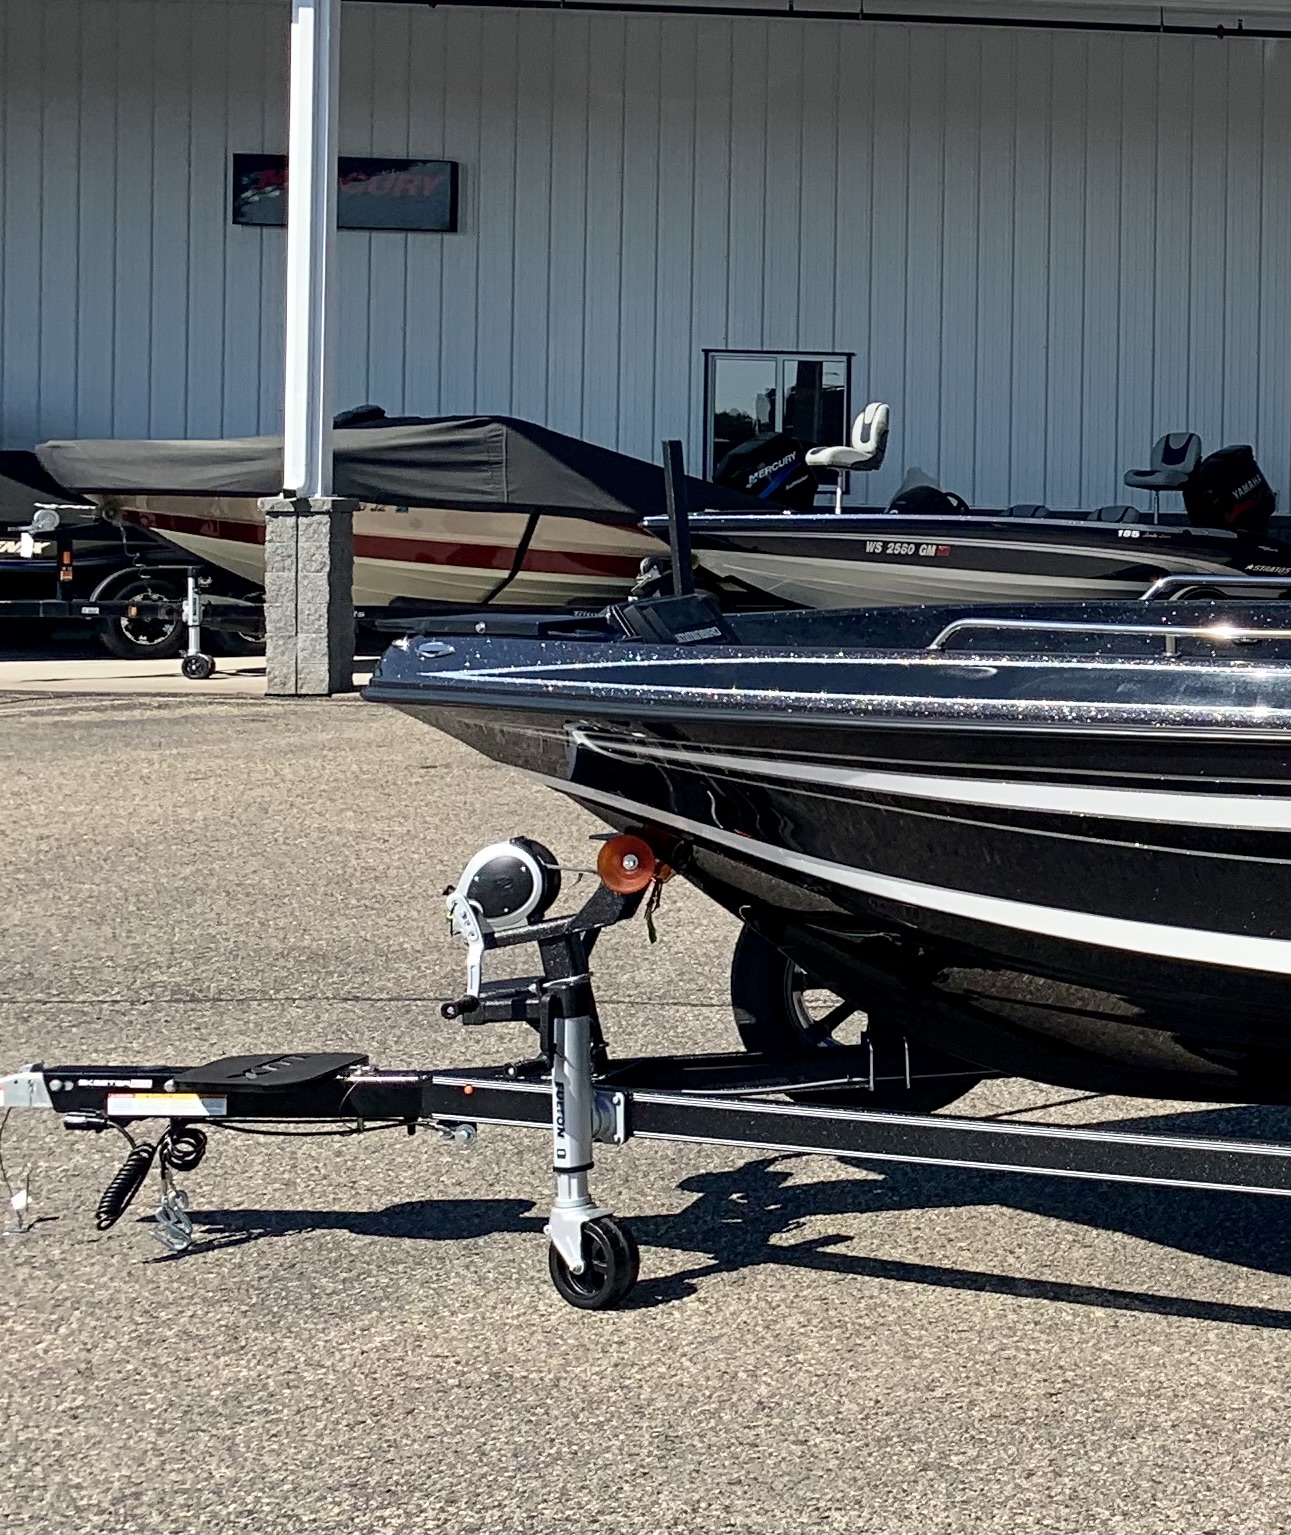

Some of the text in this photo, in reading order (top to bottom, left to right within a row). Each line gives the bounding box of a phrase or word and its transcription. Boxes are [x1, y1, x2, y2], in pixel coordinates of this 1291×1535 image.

[746, 450, 797, 488] MERCURY
[1232, 473, 1262, 500] YAMAHA
[866, 540, 883, 554] WS
[919, 544, 936, 557] GM
[1252, 564, 1291, 576] STRATOS
